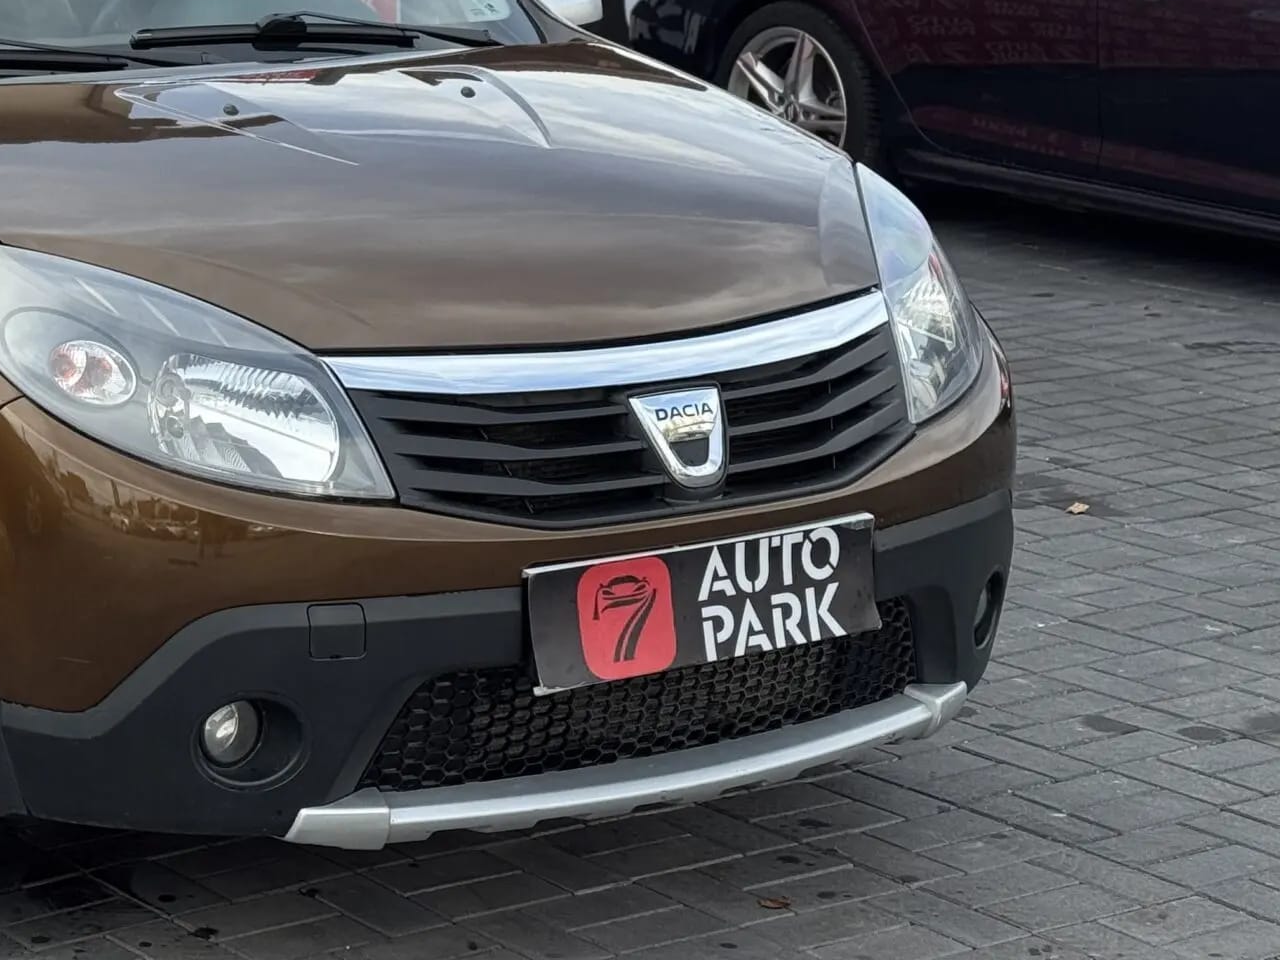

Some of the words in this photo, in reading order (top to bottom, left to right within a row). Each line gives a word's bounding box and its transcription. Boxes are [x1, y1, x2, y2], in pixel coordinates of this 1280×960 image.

[654, 401, 715, 423] DACIA
[697, 526, 841, 603] AUTO
[701, 581, 847, 662] PARK
